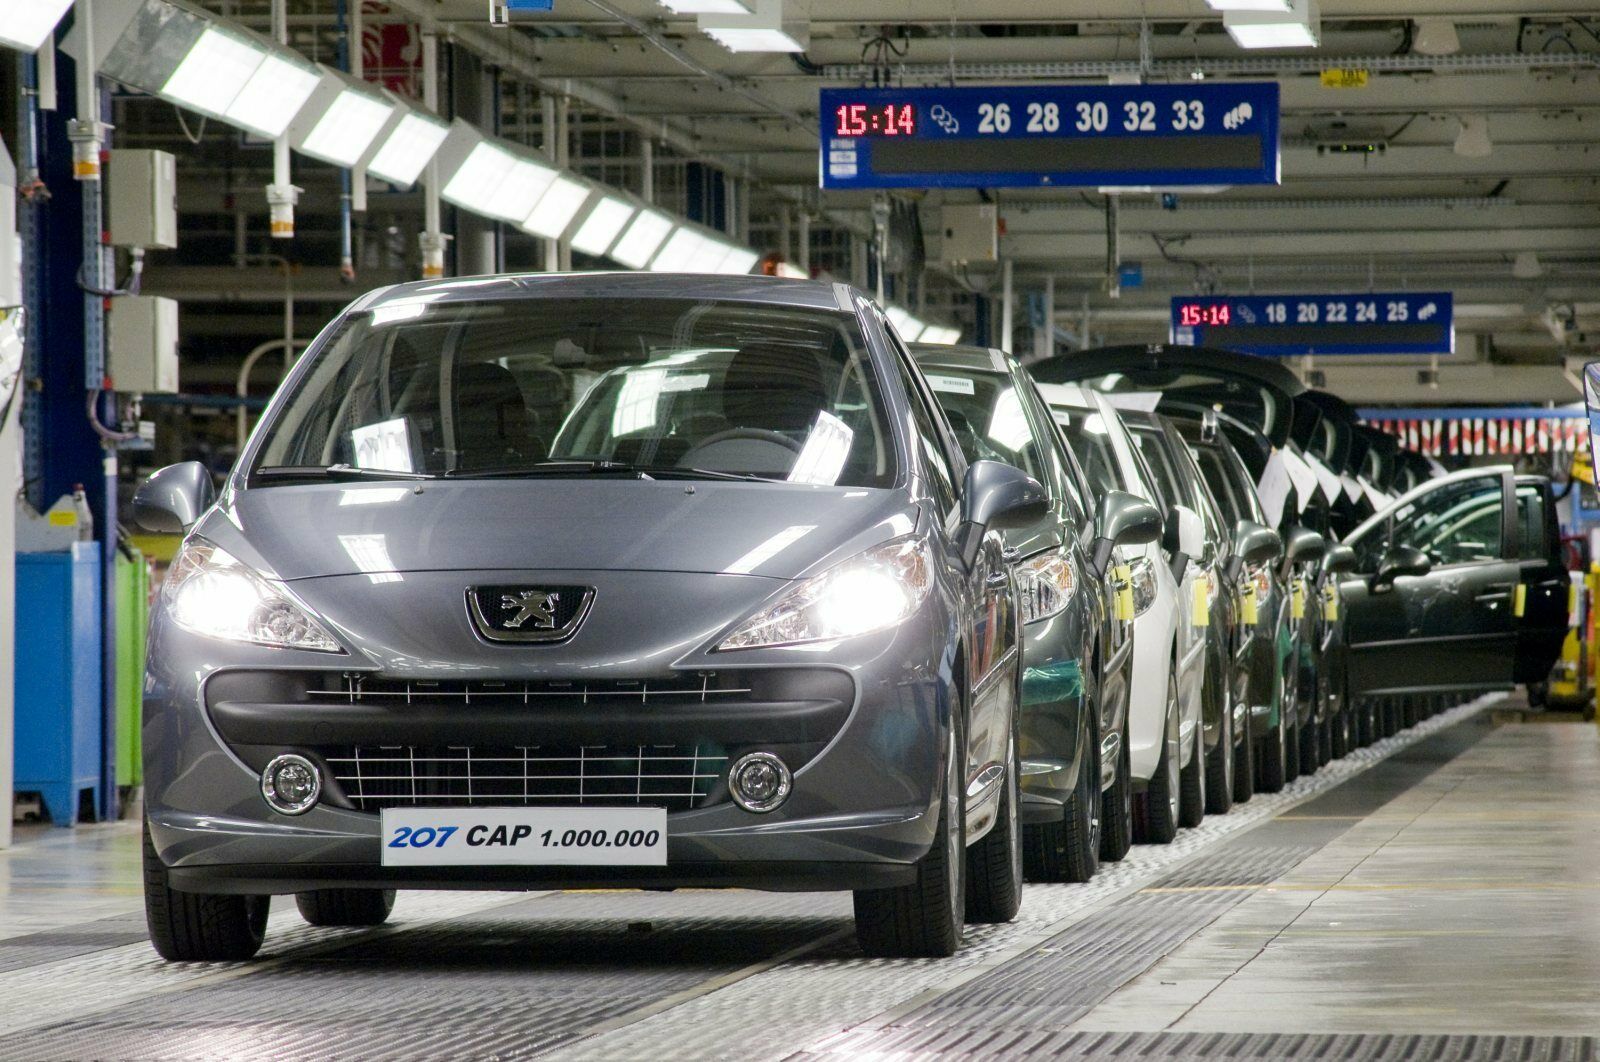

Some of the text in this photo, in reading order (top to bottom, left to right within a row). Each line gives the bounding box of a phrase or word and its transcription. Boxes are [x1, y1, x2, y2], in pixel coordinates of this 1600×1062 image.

[837, 104, 914, 135] 15:14
[978, 100, 1204, 133] 26 28 30 32 33
[1181, 304, 1230, 325] 15:14
[1265, 302, 1408, 323] 18 20 22 24 25
[388, 825, 660, 848] 207 CAP 1.000.000
